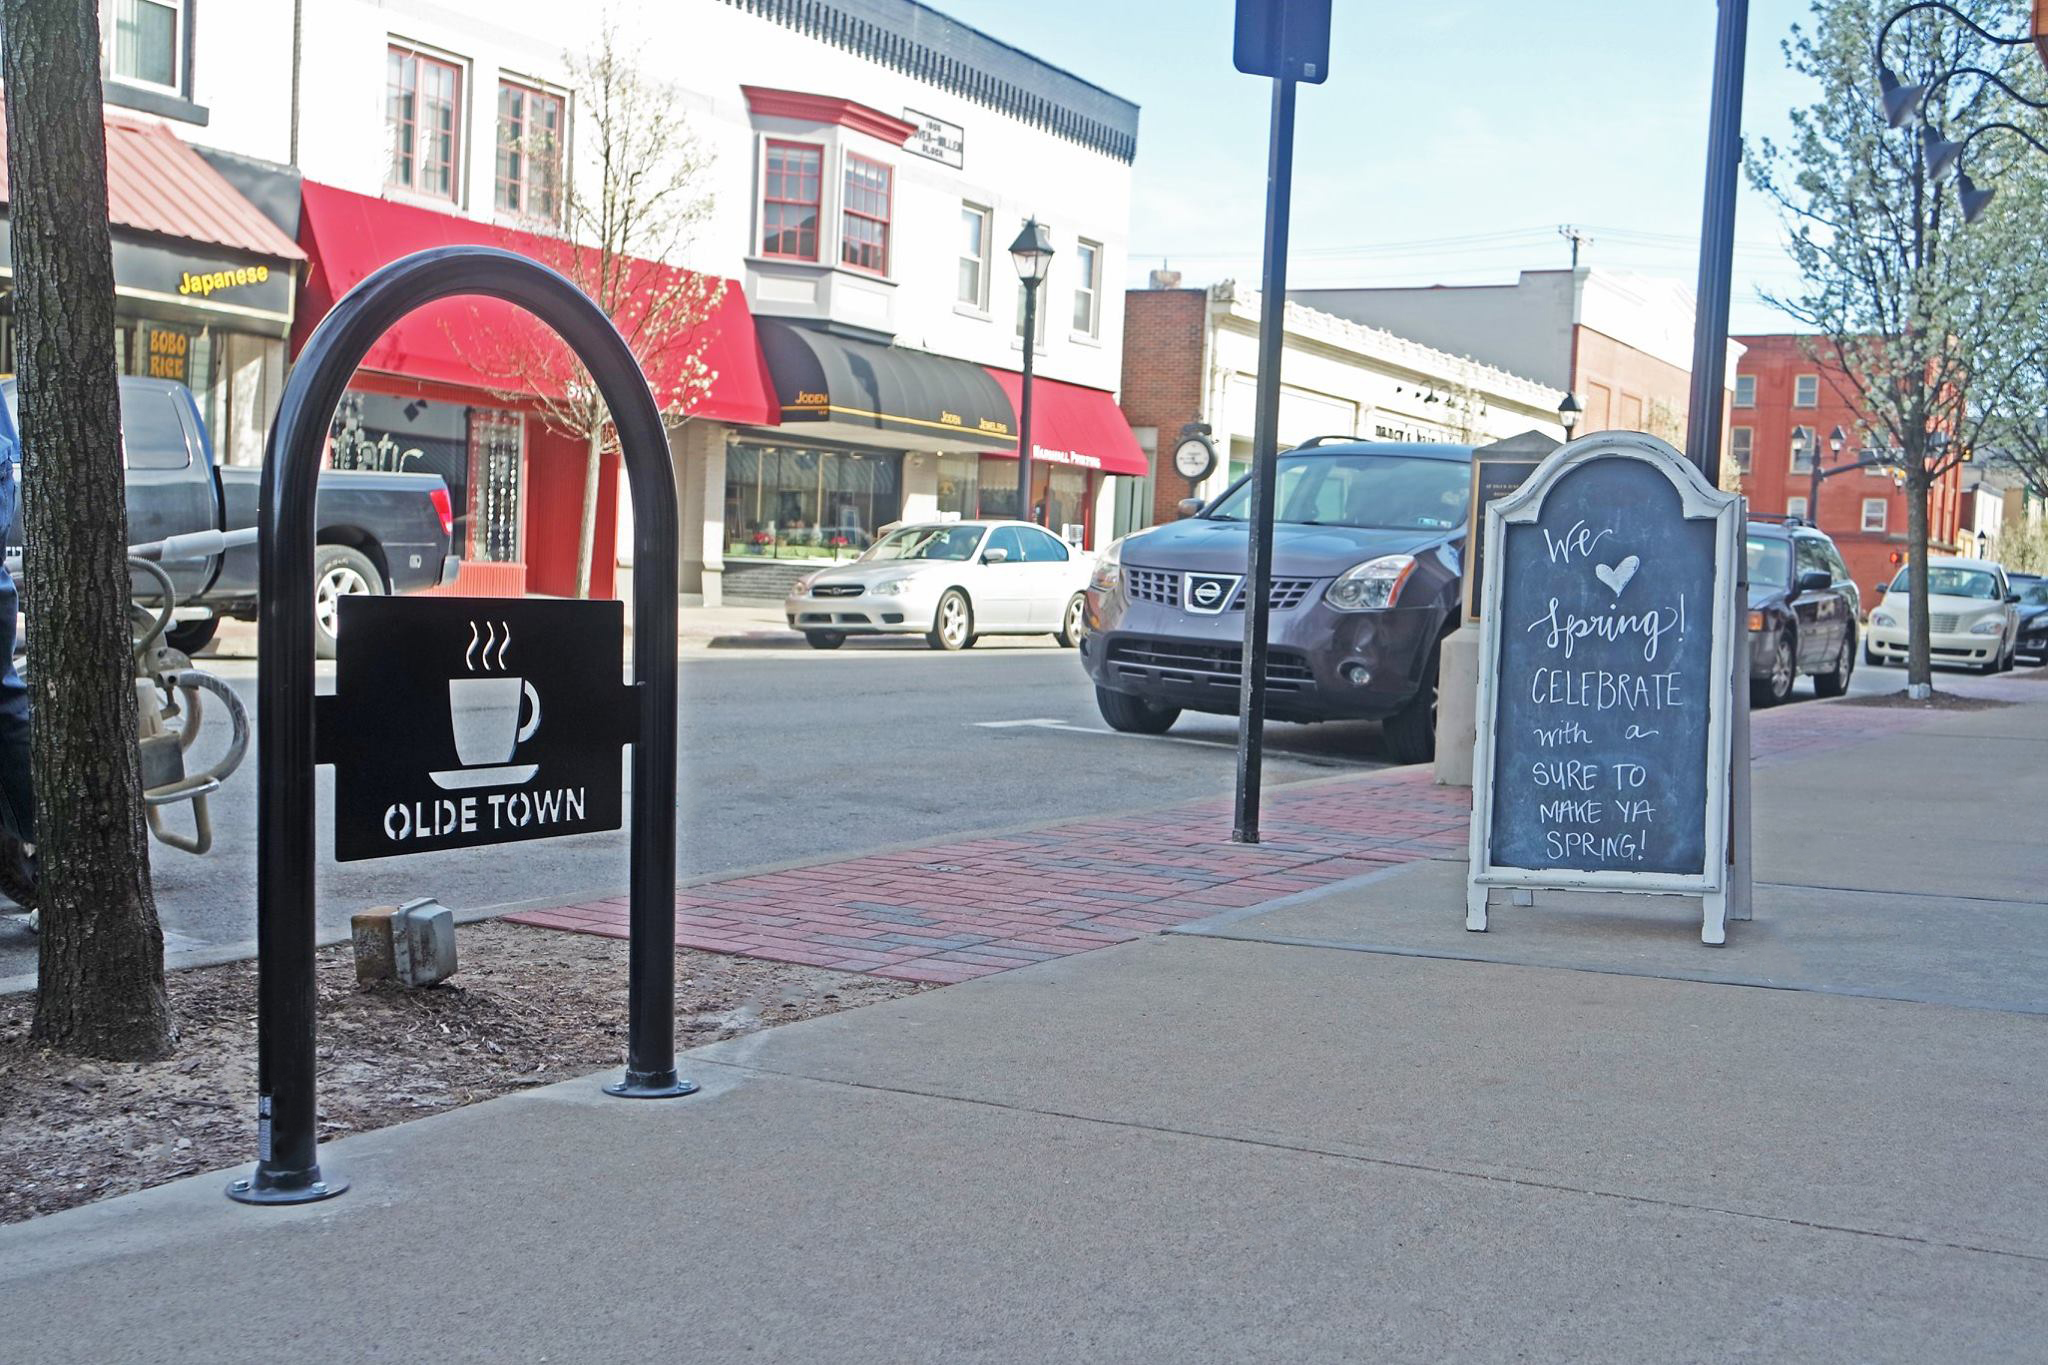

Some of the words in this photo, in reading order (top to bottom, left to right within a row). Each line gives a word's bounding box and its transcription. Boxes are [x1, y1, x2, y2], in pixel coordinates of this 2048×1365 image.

[179, 265, 269, 296] Japanese
[150, 329, 187, 356] BOBO
[149, 354, 185, 379] RICE
[1543, 520, 1613, 563] We
[1528, 593, 1685, 662] Spring!
[1532, 667, 1684, 711] CELEBRATE
[1533, 720, 1593, 747] with
[1625, 724, 1659, 740] a
[1532, 760, 1598, 790] SURE
[1612, 763, 1647, 790] TO
[384, 798, 477, 841] OLDE
[488, 787, 585, 829] TOWN
[1540, 800, 1602, 824] MAKE
[1615, 799, 1656, 823] YA
[1546, 830, 1646, 861] SPRING!
